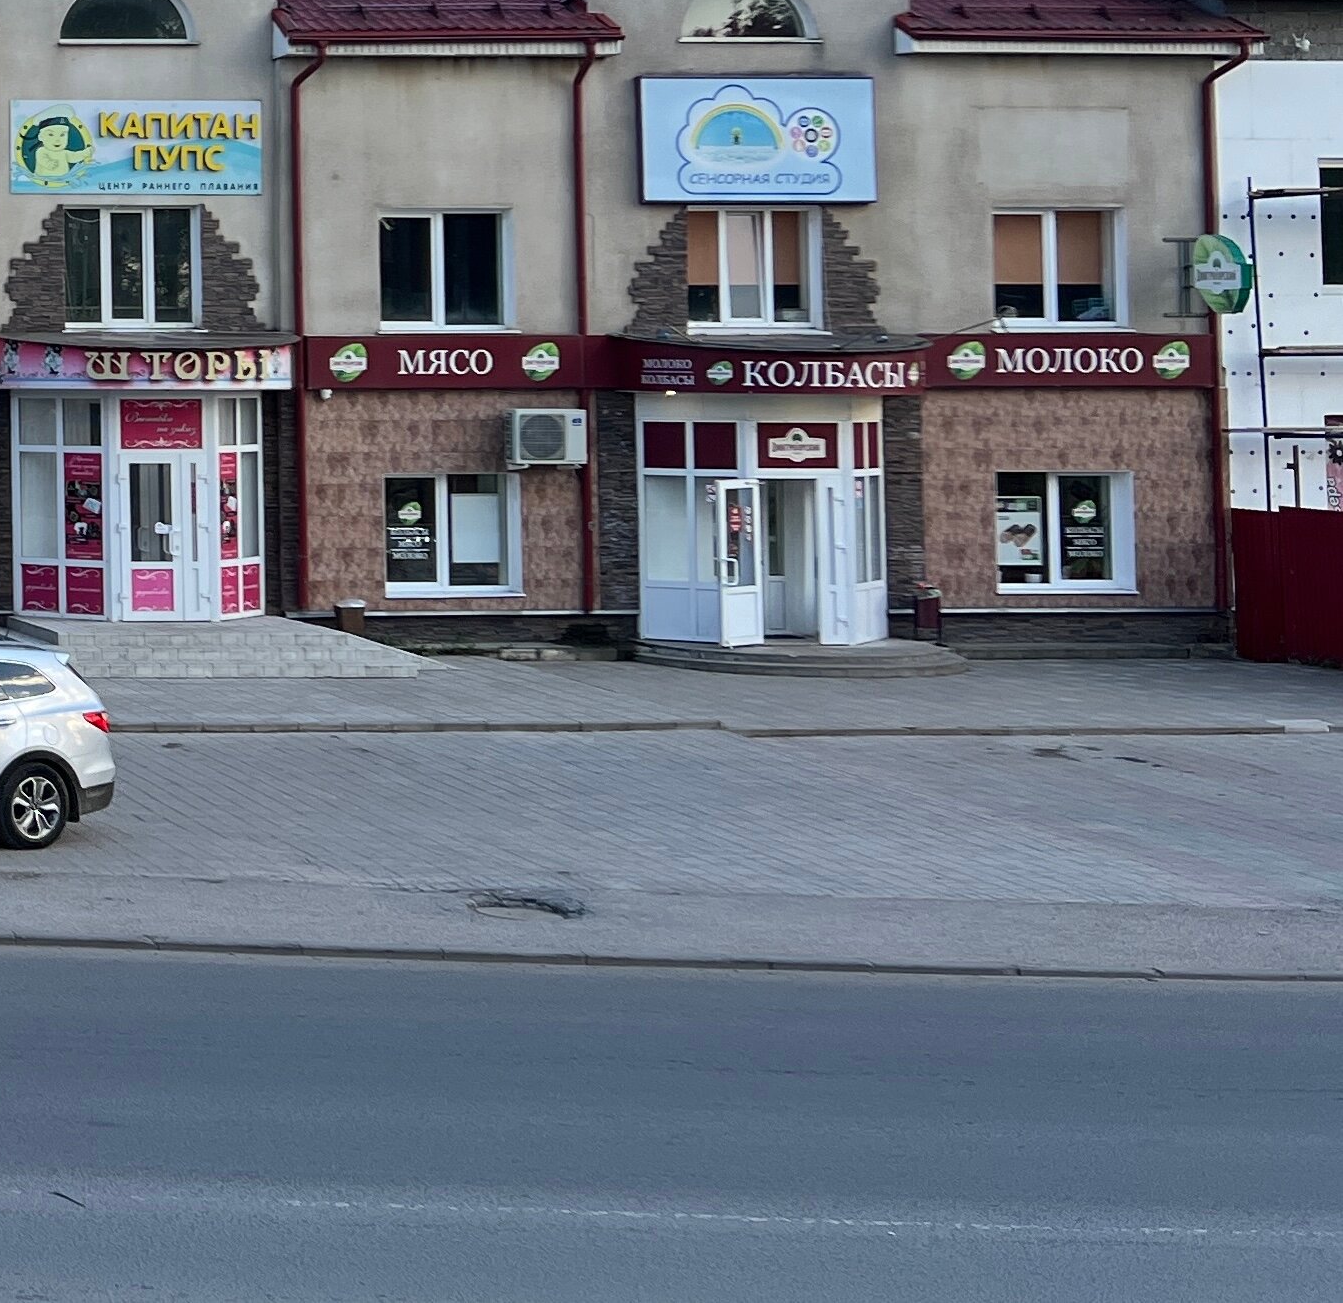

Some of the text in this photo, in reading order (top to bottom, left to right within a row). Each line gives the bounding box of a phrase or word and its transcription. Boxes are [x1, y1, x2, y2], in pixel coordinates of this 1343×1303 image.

[99, 111, 259, 139] КАПИТАН
[133, 145, 226, 172] ПУПС
[98, 182, 259, 191] ЦЕНТР РАННЕГО ПЛАВАНИЯ
[689, 173, 831, 185] СЕНСОРНАЯ СТУДИЯ
[85, 350, 272, 381] ШТОРЫ
[397, 349, 494, 375] МЯСО
[642, 359, 693, 369] МОЛОКО
[996, 348, 1144, 373] МОЛОКО
[640, 375, 696, 386] КОЛБАСЫ
[741, 361, 906, 388] КОЛБАСЫ
